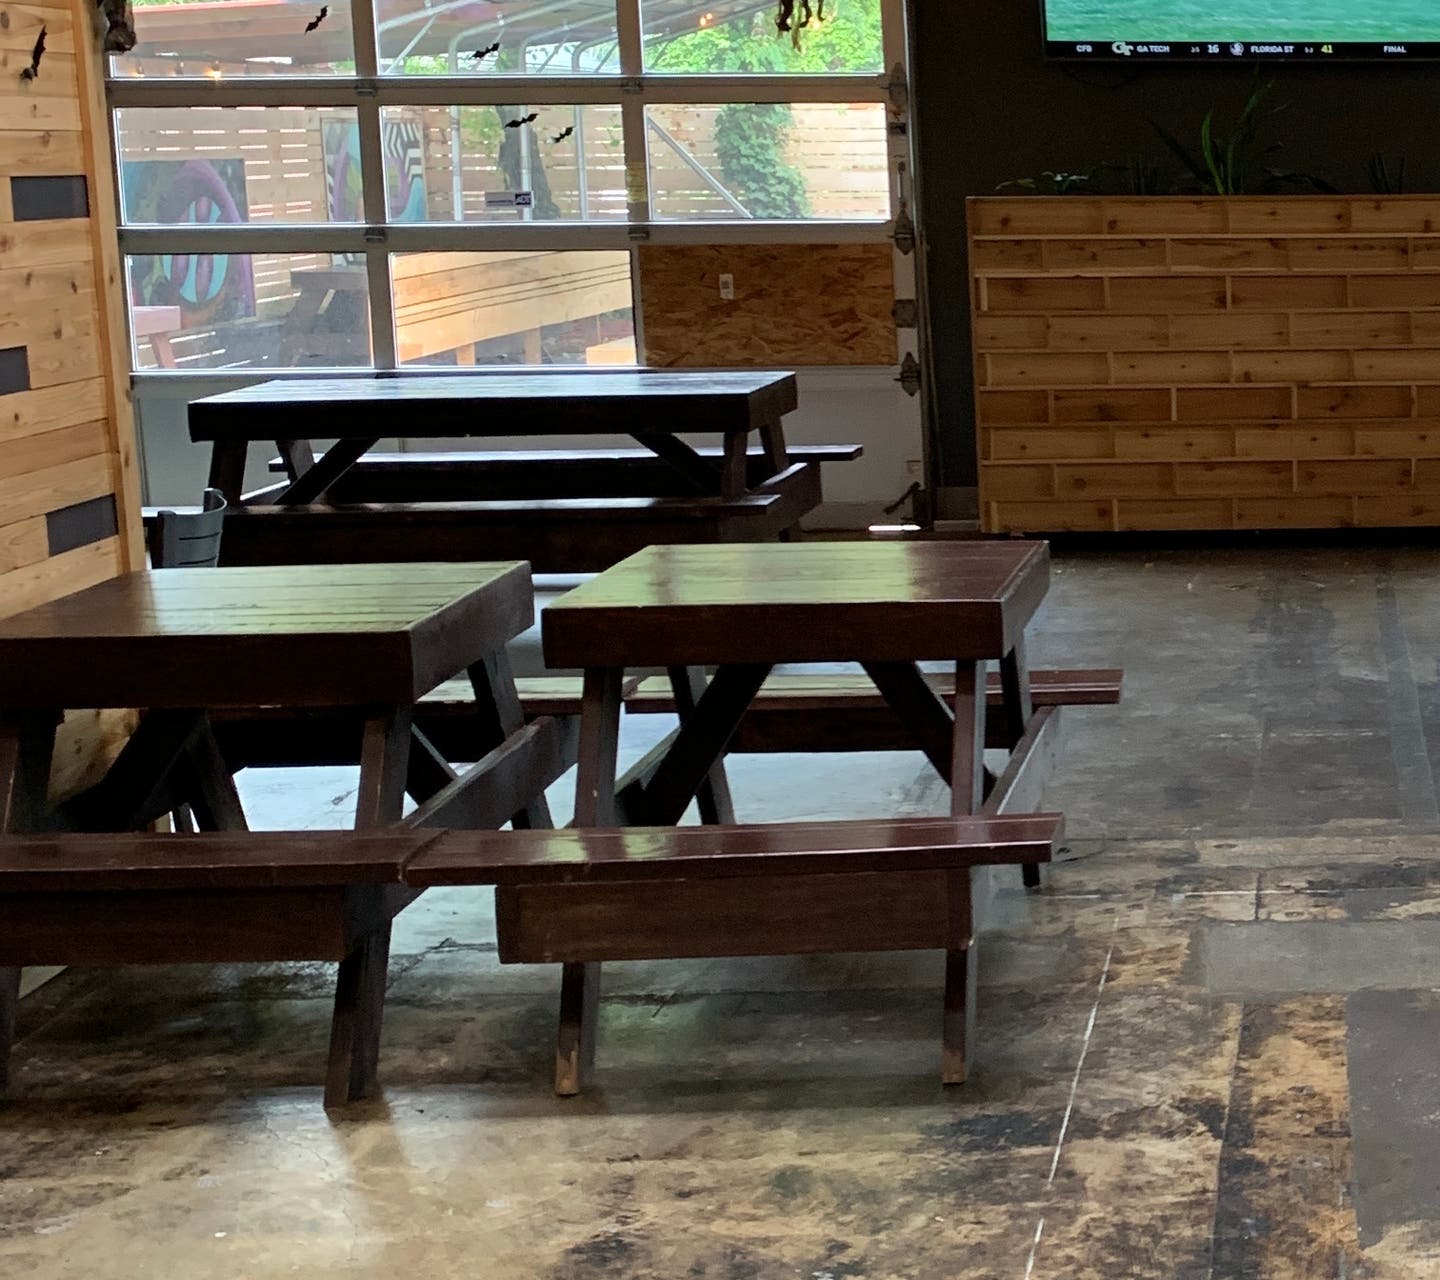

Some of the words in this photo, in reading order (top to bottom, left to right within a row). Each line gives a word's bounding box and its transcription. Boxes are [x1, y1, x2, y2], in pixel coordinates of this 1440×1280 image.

[1136, 45, 1149, 53] GA
[1150, 45, 1170, 53] TECH
[1207, 44, 1219, 54] 16
[1250, 45, 1282, 53] FLORIDA
[1284, 45, 1294, 53] ST
[1321, 44, 1333, 54] 41
[1383, 45, 1407, 53] FINAL
